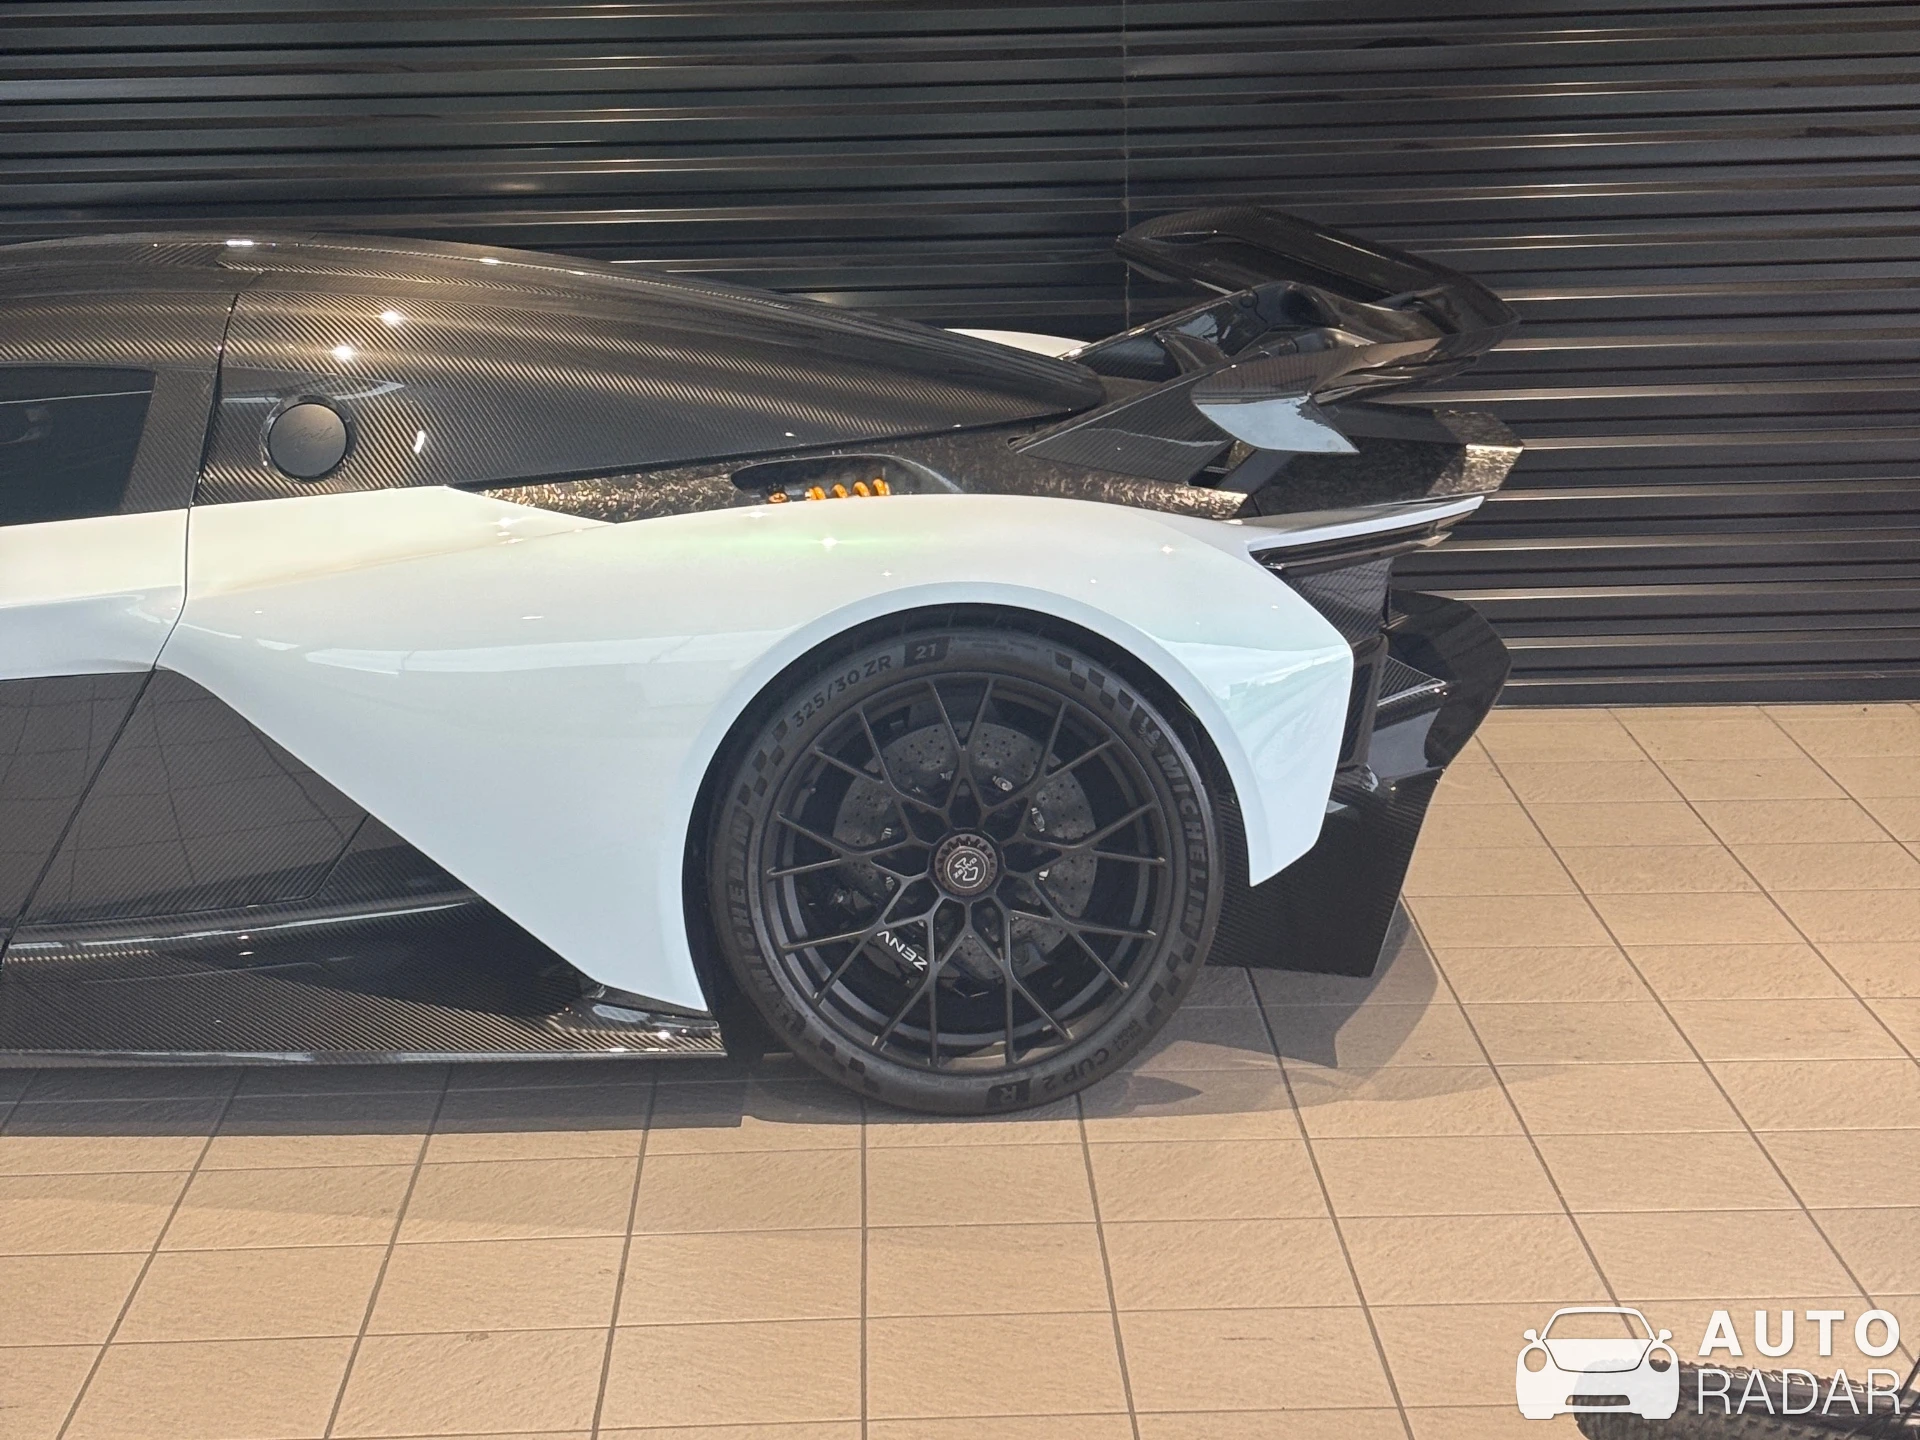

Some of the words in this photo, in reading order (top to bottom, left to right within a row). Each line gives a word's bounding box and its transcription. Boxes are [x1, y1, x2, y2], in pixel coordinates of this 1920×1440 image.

[792, 669, 860, 728] 325/30
[864, 655, 892, 678] ZR
[914, 643, 937, 660] 21
[1157, 754, 1208, 933] MICHELIN
[727, 812, 778, 997] MICHELIN
[877, 930, 928, 971] ZENV
[1042, 1074, 1057, 1092] 2
[1062, 1047, 1110, 1083] CUP
[1000, 1085, 1017, 1100] R
